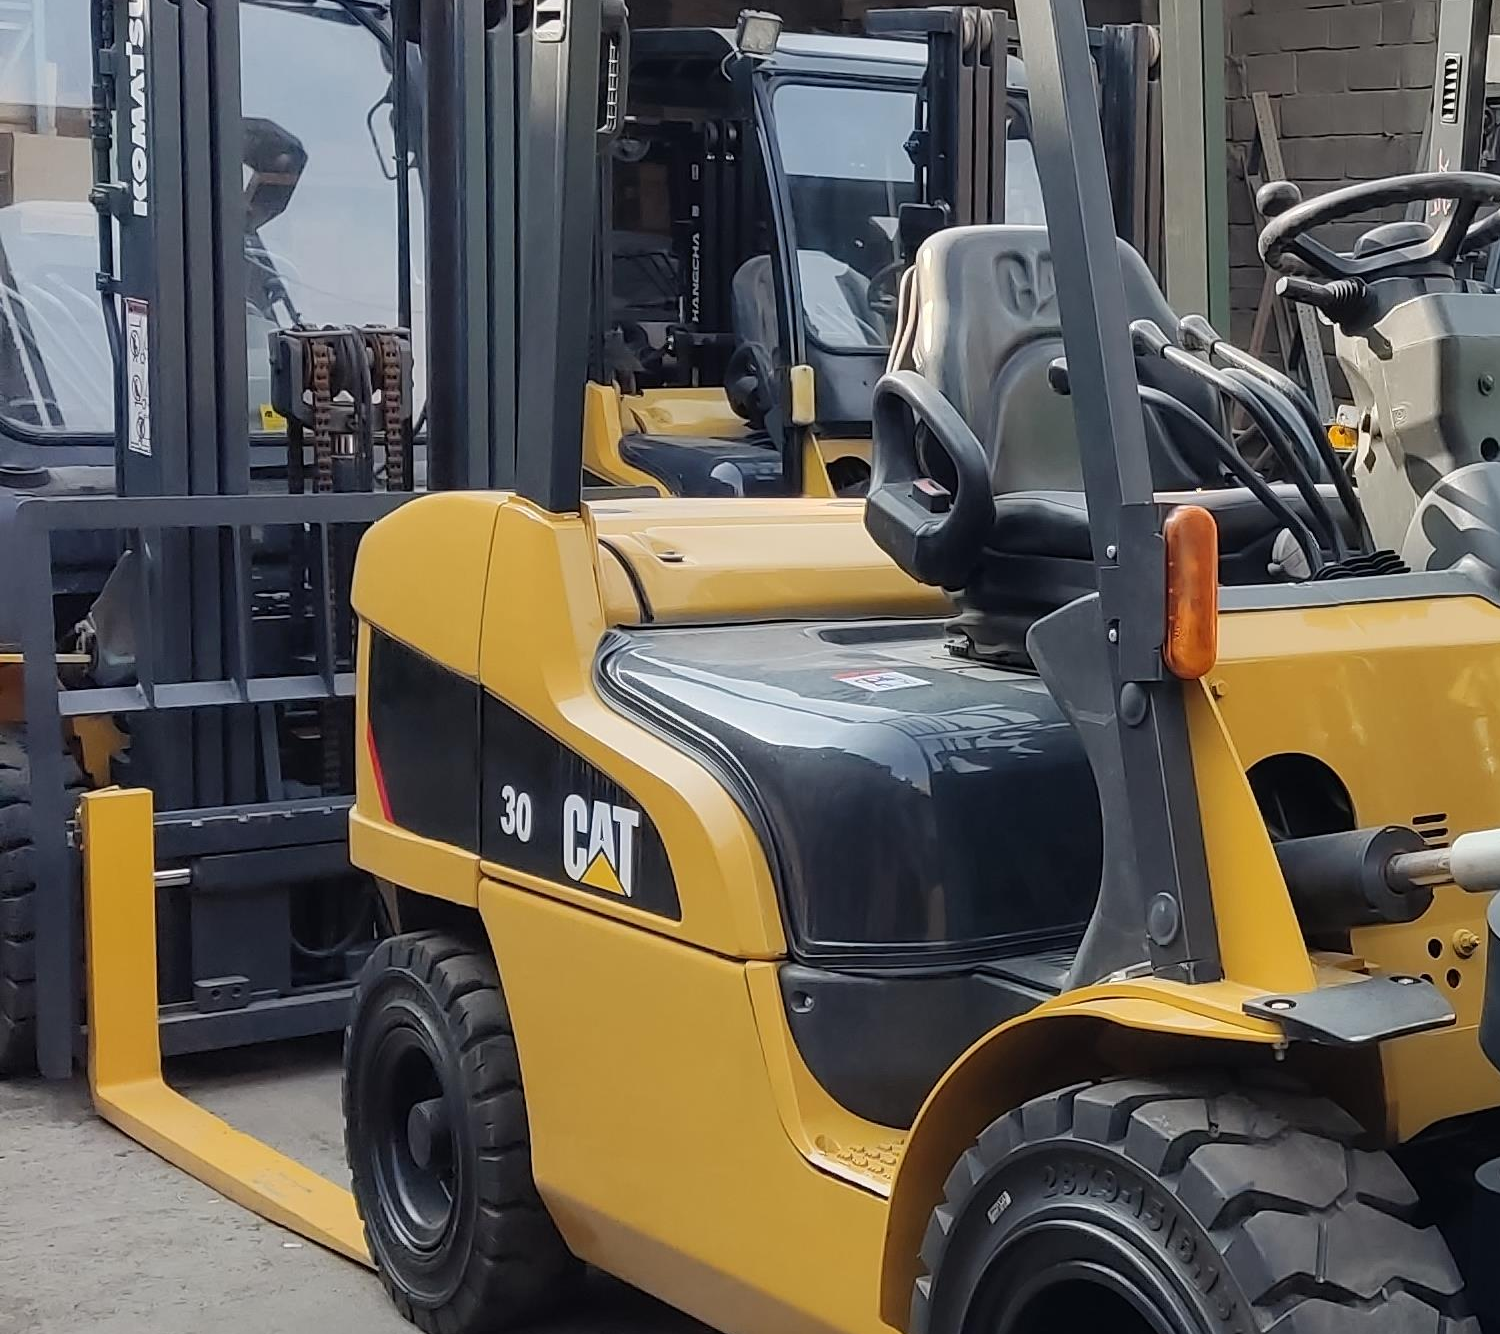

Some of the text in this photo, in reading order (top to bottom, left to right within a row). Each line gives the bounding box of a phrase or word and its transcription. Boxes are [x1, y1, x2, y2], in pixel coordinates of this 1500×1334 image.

[691, 232, 701, 324] HANGCHA
[500, 785, 640, 899] 30 CAT
